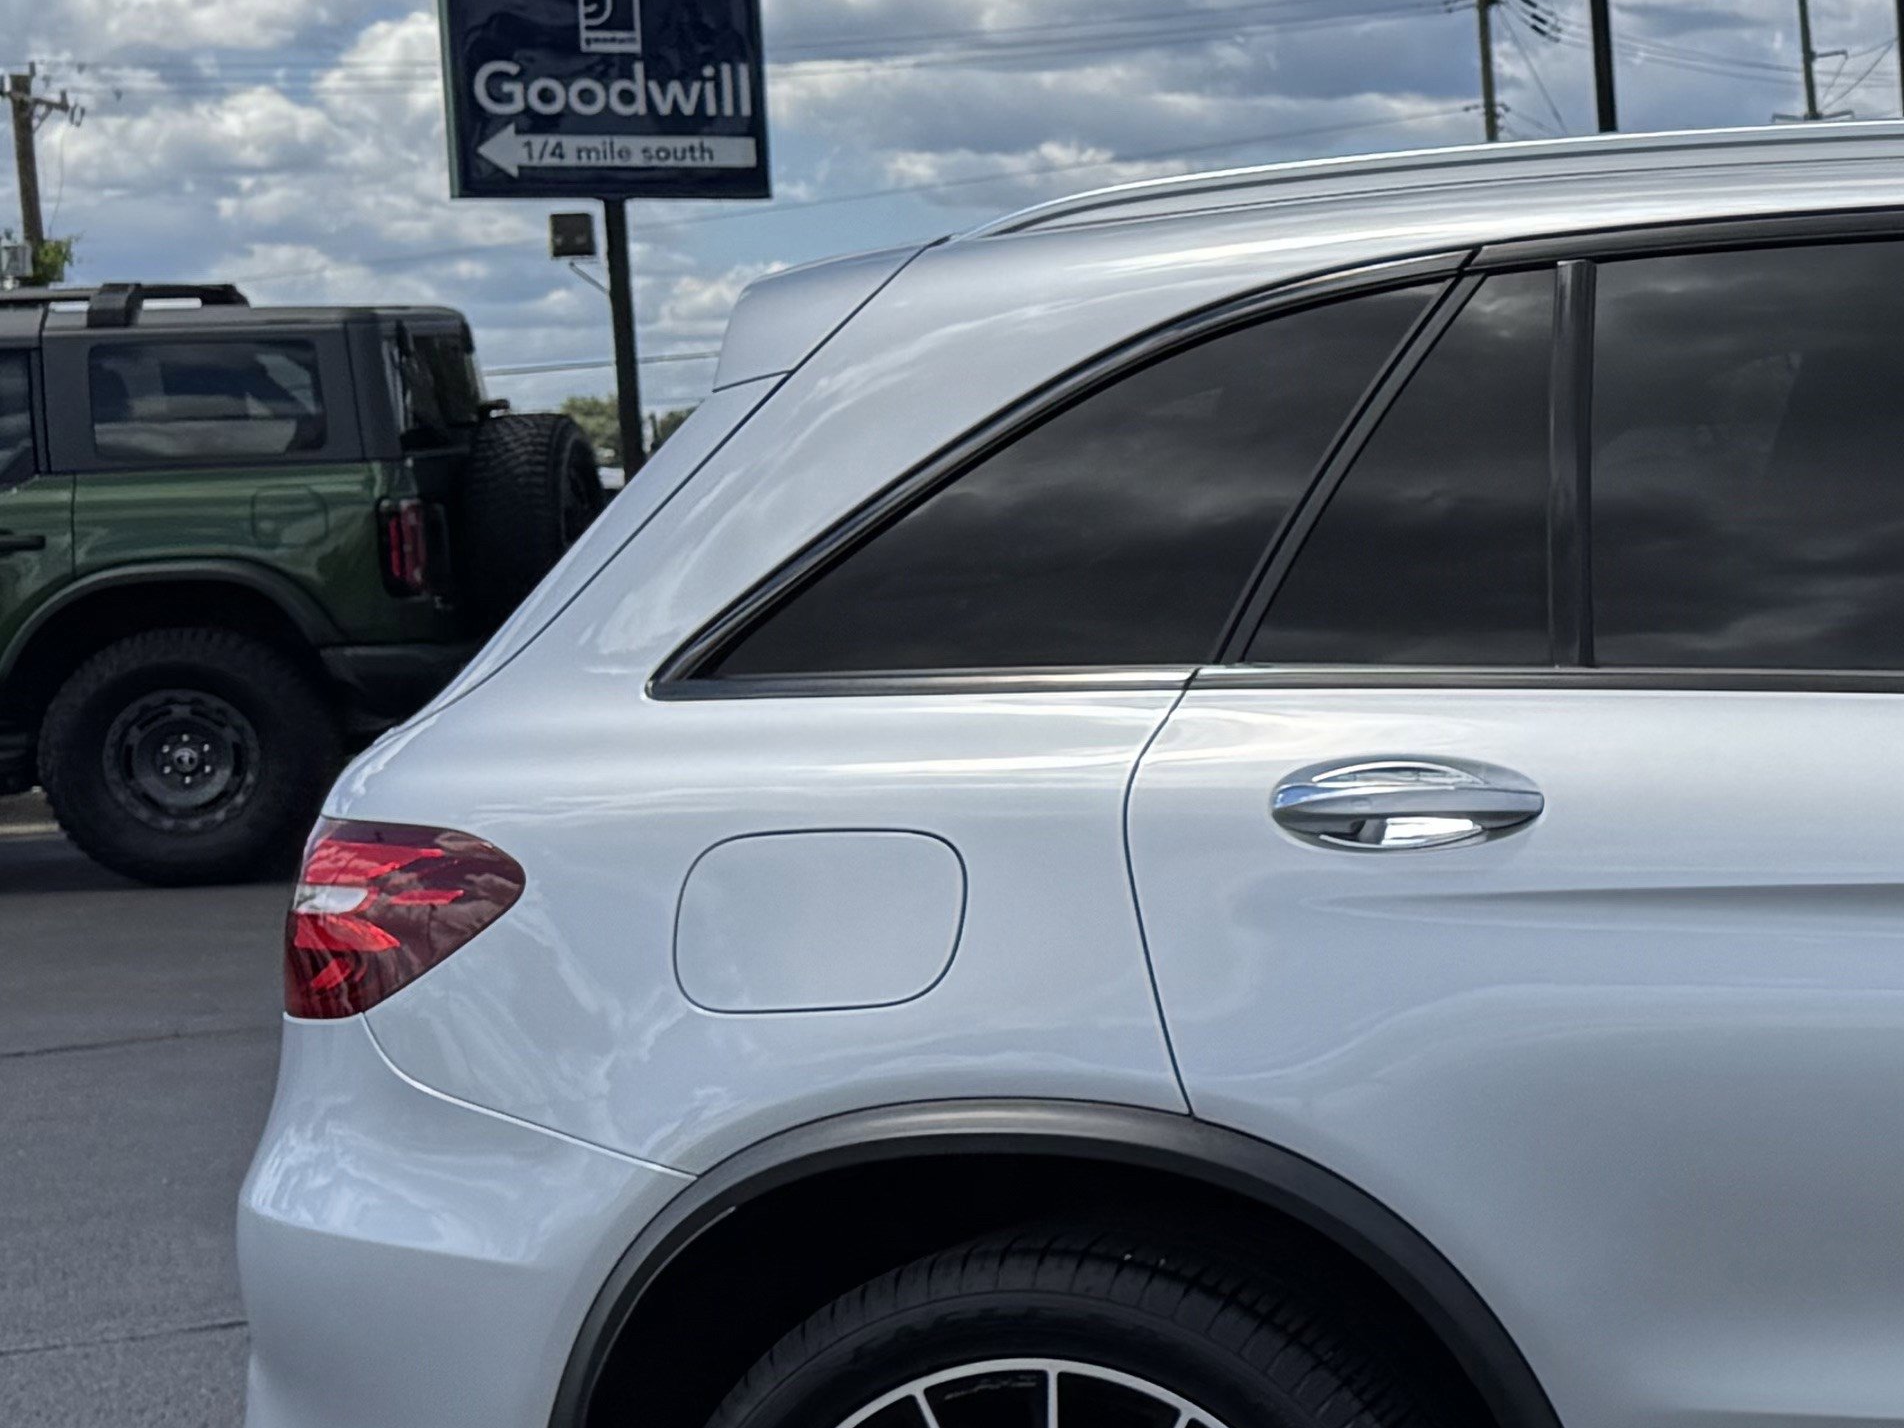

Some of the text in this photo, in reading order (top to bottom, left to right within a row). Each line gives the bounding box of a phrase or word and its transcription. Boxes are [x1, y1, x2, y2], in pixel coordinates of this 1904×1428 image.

[474, 59, 752, 117] Goodwill
[523, 140, 715, 163] 1/4 mile south
